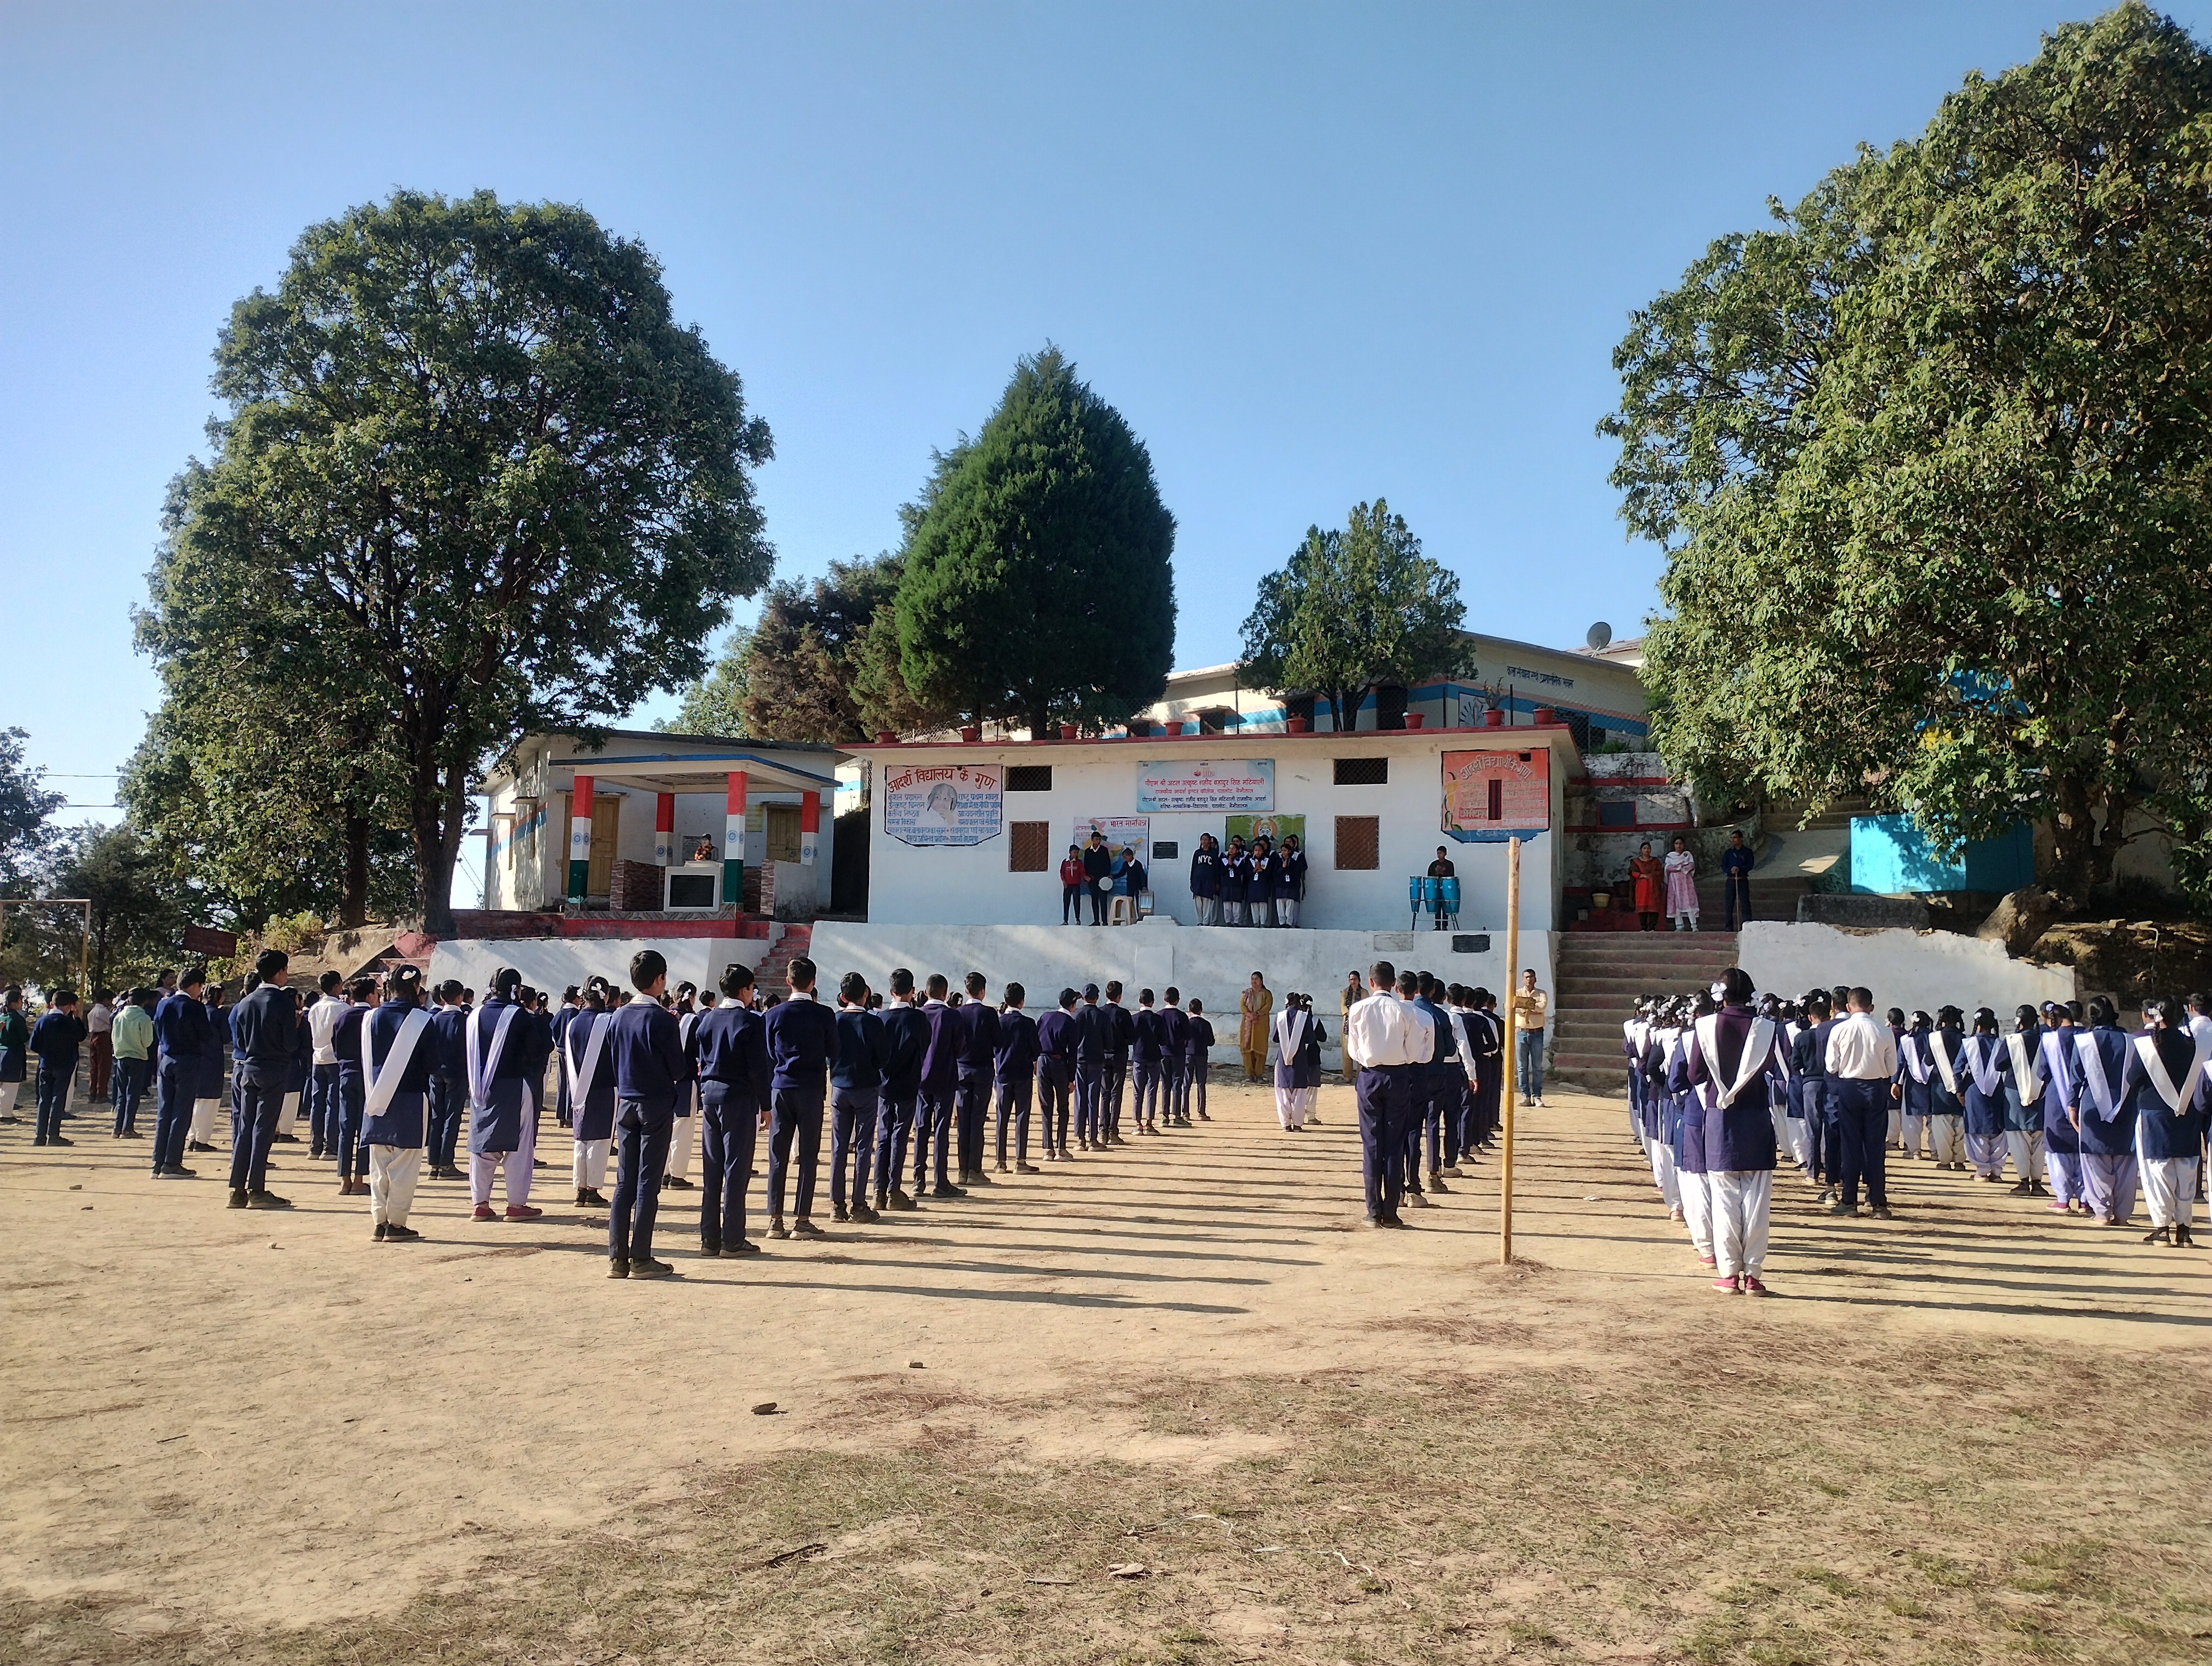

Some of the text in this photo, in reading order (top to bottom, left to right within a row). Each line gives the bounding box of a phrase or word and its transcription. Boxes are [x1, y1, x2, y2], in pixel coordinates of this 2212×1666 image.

[1460, 754, 1483, 779] आदर्श
[1517, 763, 1533, 780] गुण
[888, 767, 997, 793] आदर्श विद्यालय के गुण
[1230, 778, 1240, 786] सिंह
[1125, 818, 1147, 827] मानचित्र
[1198, 855, 1212, 865] NYC
